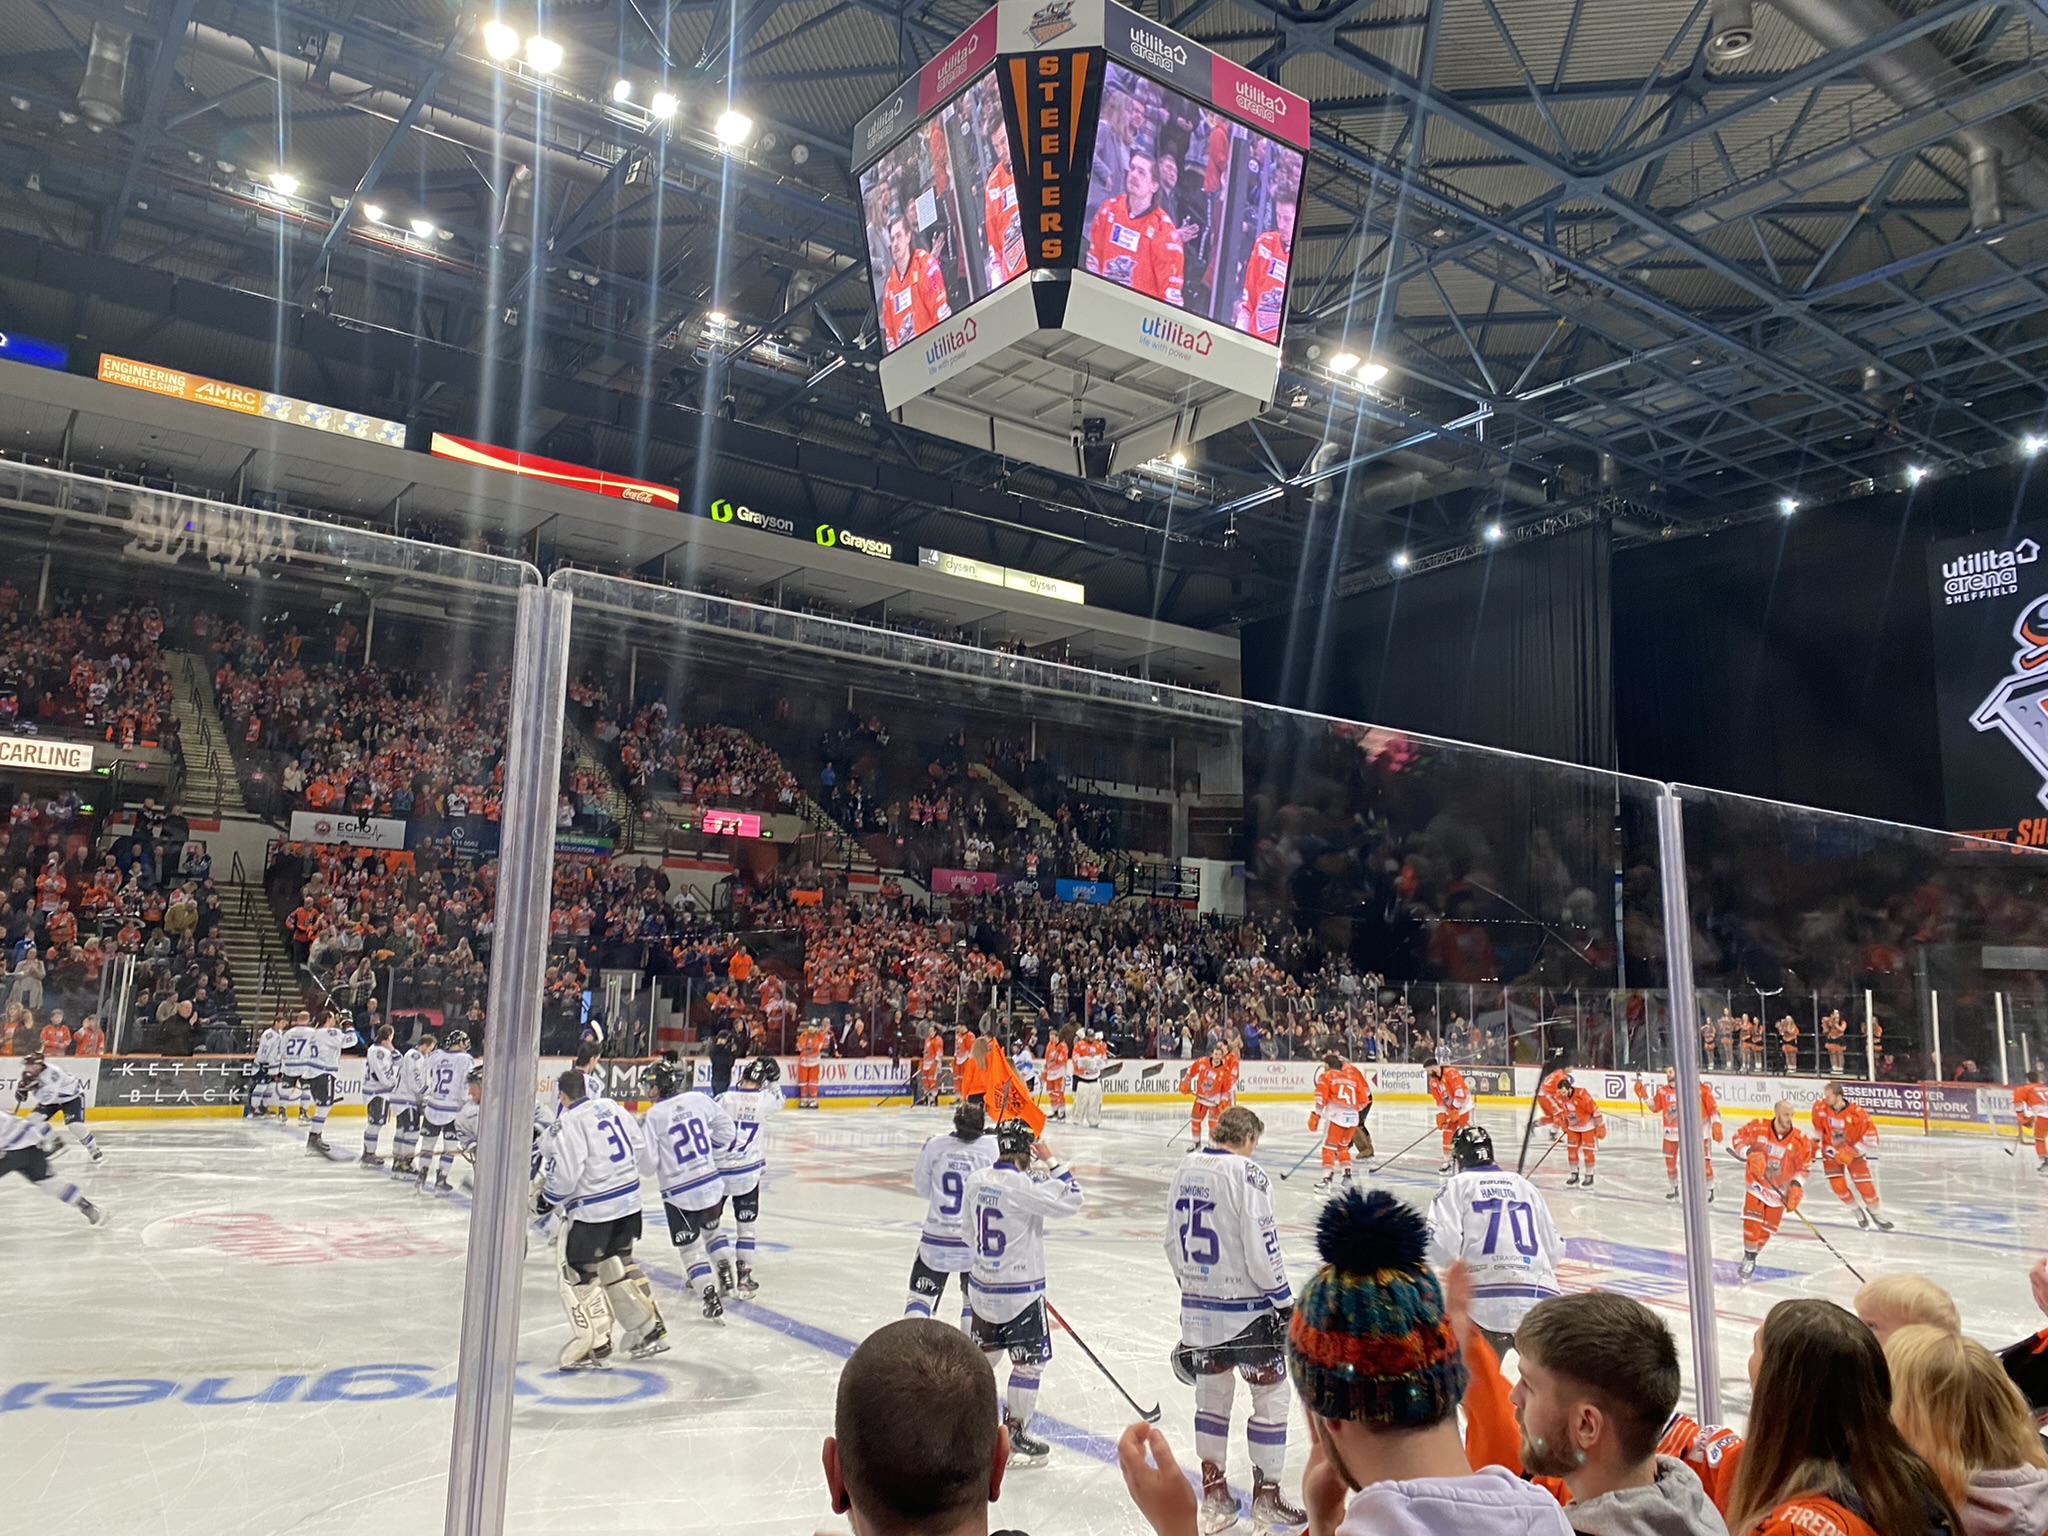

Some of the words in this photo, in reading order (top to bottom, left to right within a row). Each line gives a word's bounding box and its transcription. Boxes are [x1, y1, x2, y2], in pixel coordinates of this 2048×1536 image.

[1130, 27, 1174, 58] utilita
[937, 47, 968, 80] utilita
[1130, 41, 1173, 72] arena
[1235, 81, 1275, 110] utilita
[1236, 95, 1275, 123] arena
[868, 106, 894, 138] utilita
[1038, 56, 1062, 259] STEELERS
[1141, 317, 1194, 350] utilita
[926, 331, 965, 364] utilita
[1168, 347, 1192, 361] power
[102, 370, 184, 396] APPRENTICESHIPS
[103, 358, 186, 387] ENGINEERING
[194, 393, 227, 405] TRAINING
[229, 401, 255, 412] CENTRE
[195, 383, 256, 404] AMRC
[736, 506, 794, 532] Grayson
[839, 530, 892, 556] Grayson
[945, 558, 976, 574] dyson
[1942, 549, 2016, 578] utilita
[1029, 577, 1057, 592] dyson
[1944, 567, 2017, 595] arena
[1945, 585, 2018, 605] SHEFFIELD
[0, 742, 81, 767] CARLING
[337, 822, 371, 834] ECHO
[286, 1038, 308, 1056] 27
[122, 1063, 253, 1077] KETTLE
[433, 1068, 454, 1095] 12
[787, 1063, 848, 1081] WDOW
[854, 1063, 908, 1081] CENTRE
[1248, 1075, 1278, 1085] CROWNE
[1281, 1075, 1305, 1086] PLAZA
[1381, 1068, 1425, 1080] Keepmoat
[129, 1088, 242, 1103] BLACK
[334, 1079, 361, 1094] sun
[1100, 1079, 1129, 1093] ARLING
[1134, 1079, 1170, 1093] CARLING
[1381, 1080, 1411, 1091] Homes
[1781, 1090, 1825, 1101] UNISON
[1842, 1086, 1901, 1099] ESSENTIAL
[1932, 1102, 1969, 1113] WORK
[598, 1115, 634, 1163] 31
[668, 1117, 710, 1165] 28
[1480, 1187, 1516, 1200] HAMILTON
[975, 1205, 1007, 1258] 16
[1471, 1198, 1538, 1257] 70
